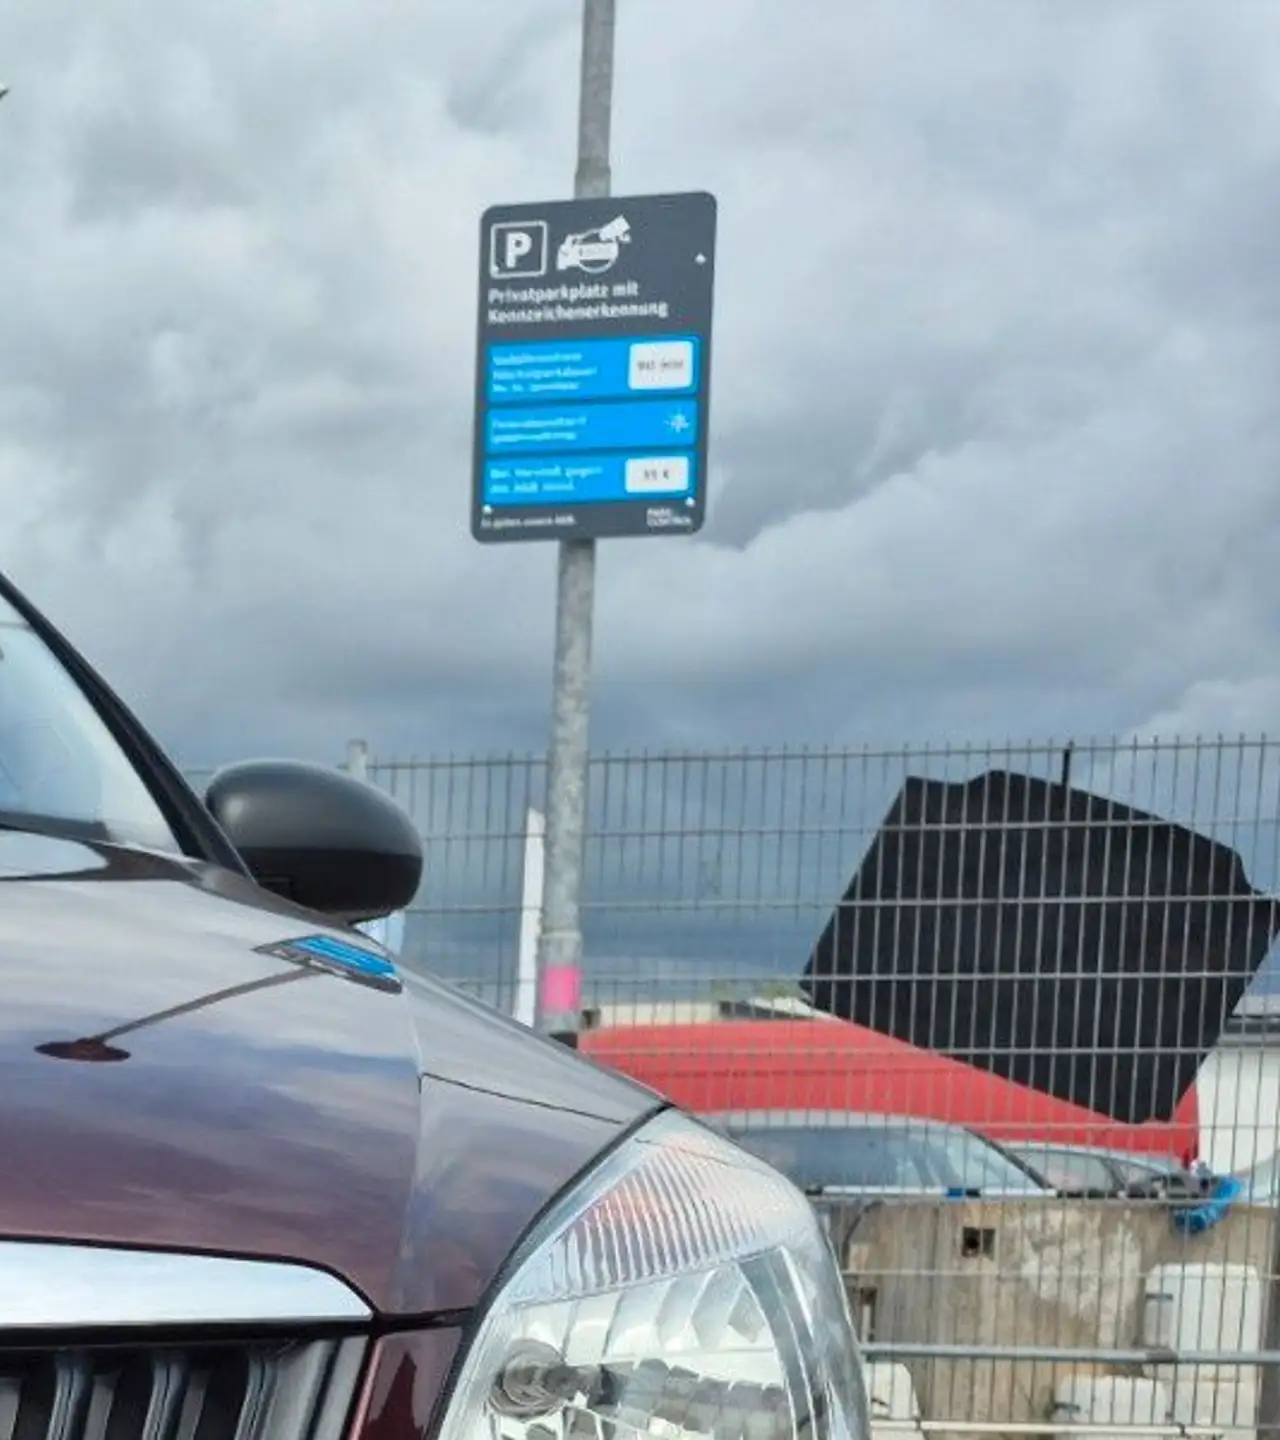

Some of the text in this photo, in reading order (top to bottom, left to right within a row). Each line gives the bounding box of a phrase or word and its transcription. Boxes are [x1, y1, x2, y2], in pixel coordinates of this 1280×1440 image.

[505, 231, 532, 269] P
[488, 280, 639, 302] Privatparkplatz mit
[487, 302, 668, 323] Kennzeichenerkennung
